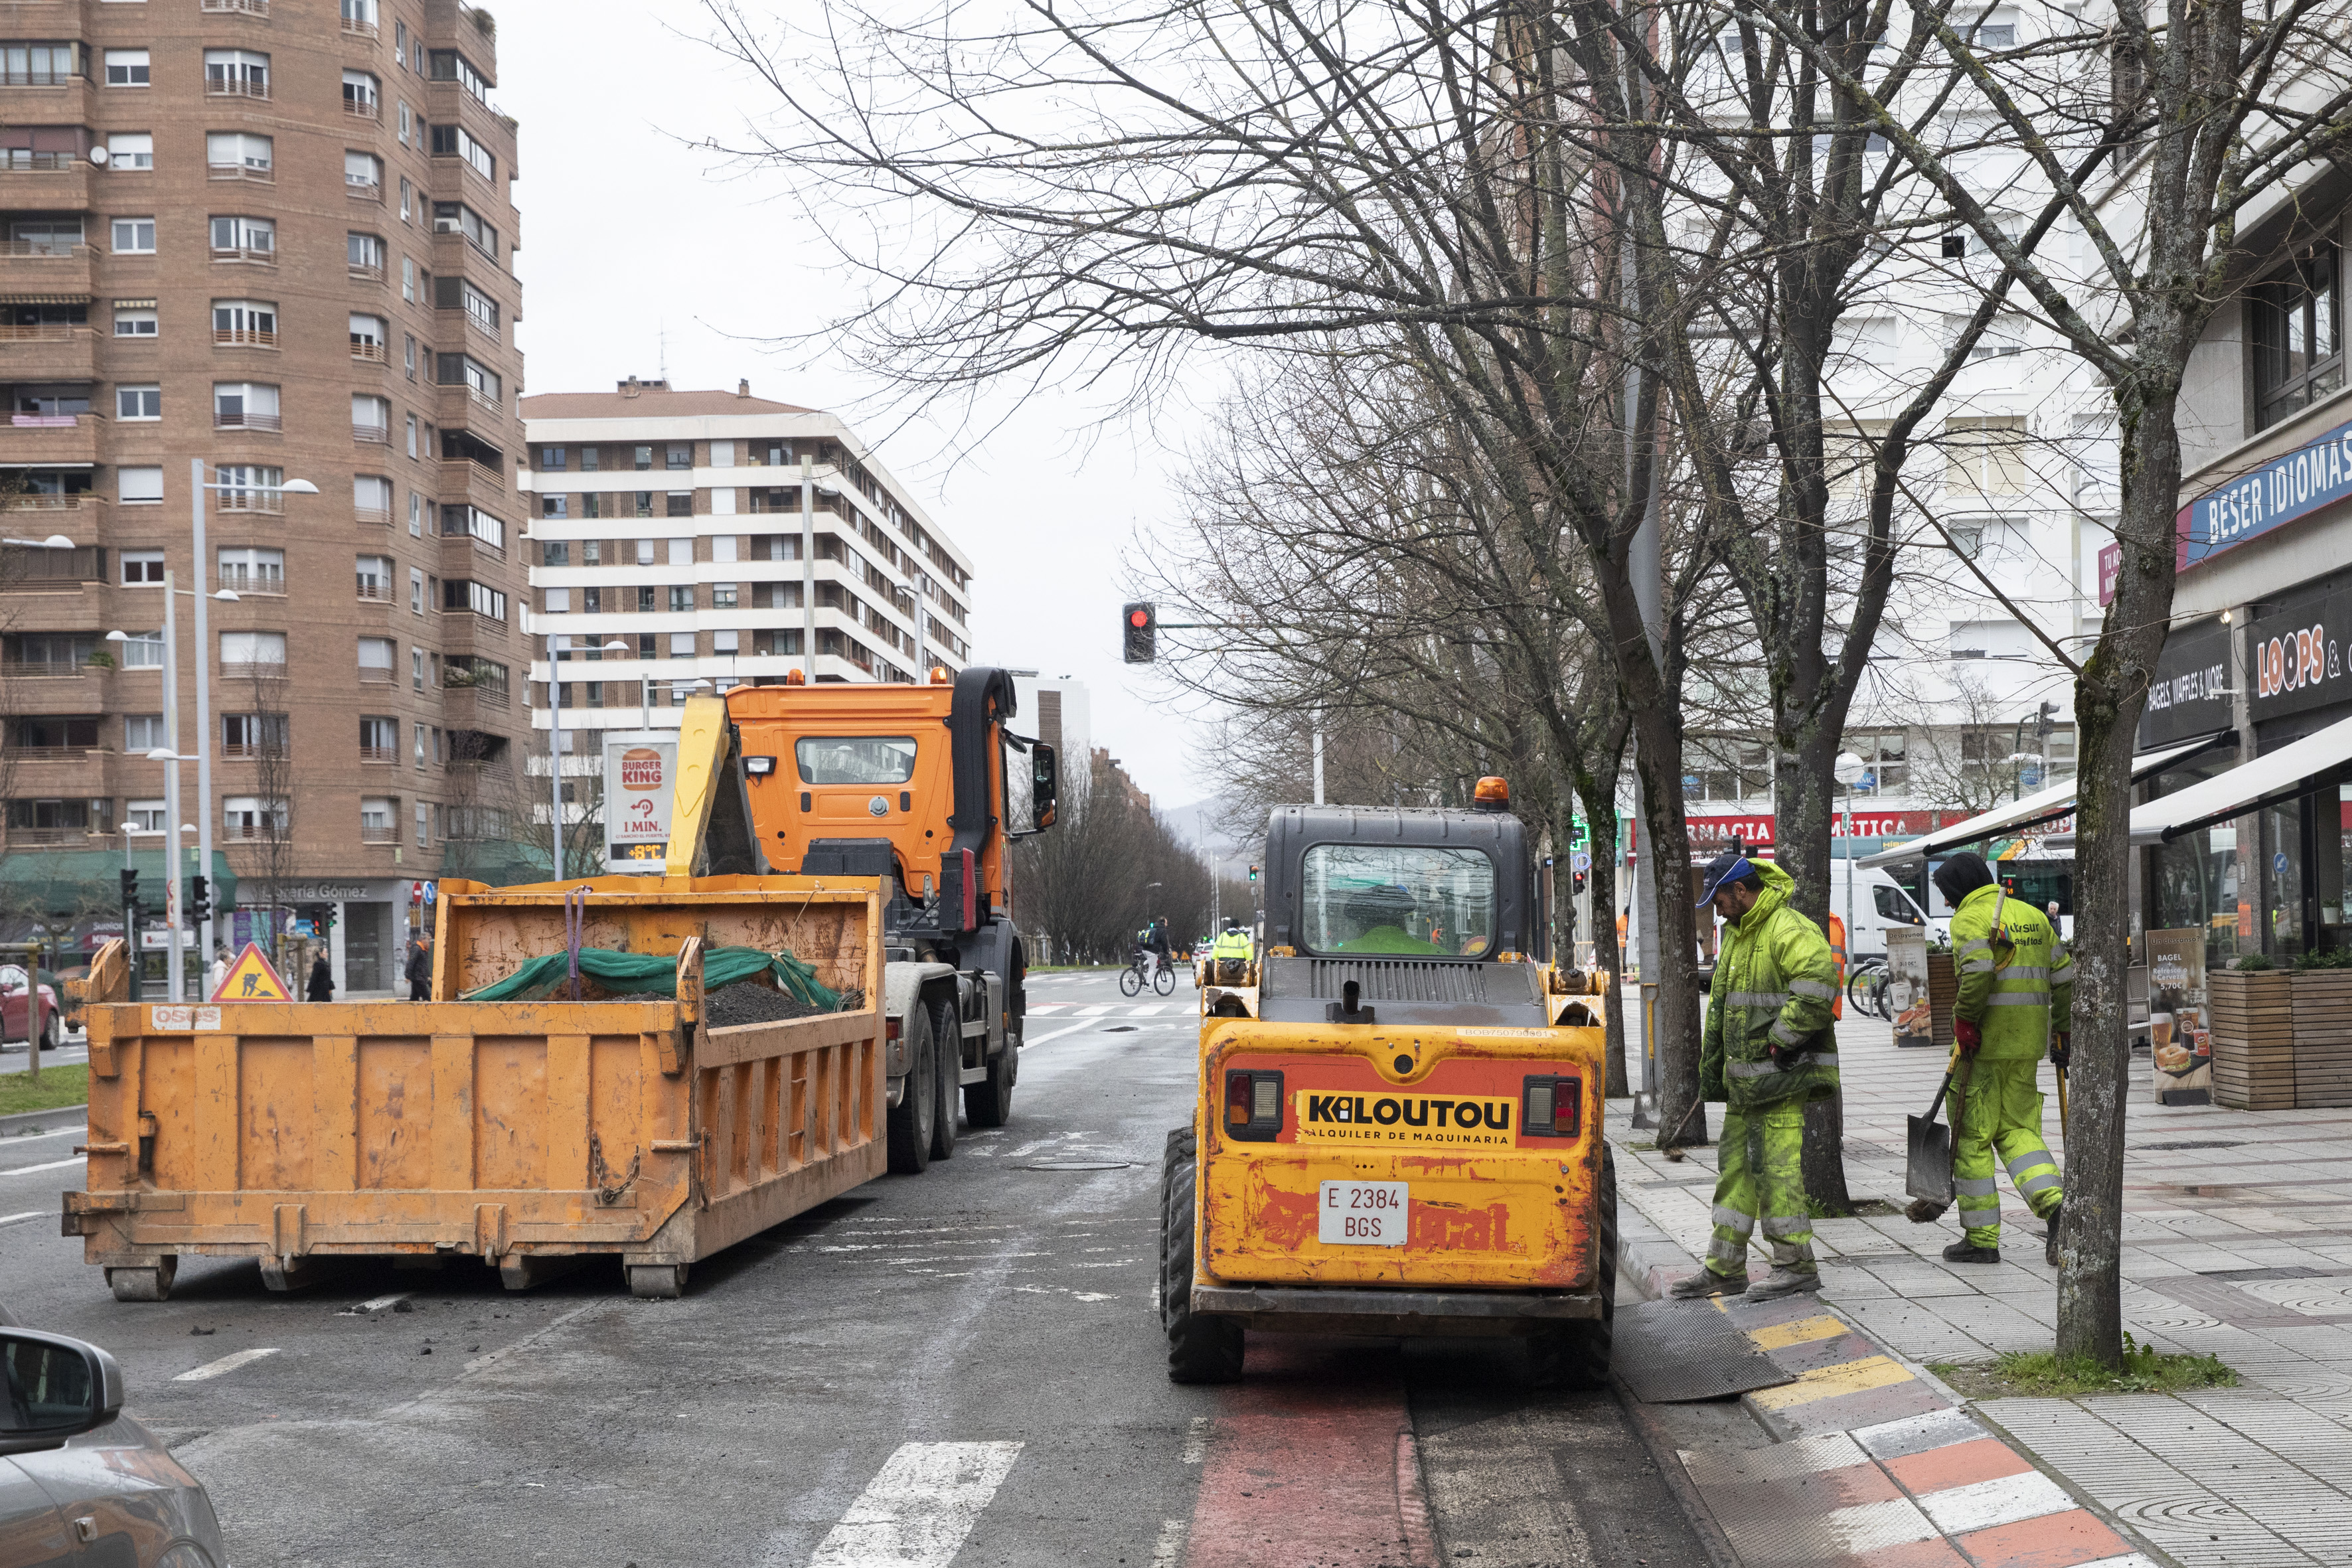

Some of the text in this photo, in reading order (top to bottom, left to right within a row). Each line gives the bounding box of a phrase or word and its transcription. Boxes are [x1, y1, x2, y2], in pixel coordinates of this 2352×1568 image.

[2209, 430, 2352, 544] BESER IDIOMAS
[2104, 553, 2112, 571] TU
[2258, 623, 2323, 698] LOOPS
[2327, 640, 2341, 678] &
[2172, 671, 2198, 705] WAFFLES
[2199, 670, 2205, 698] &
[2205, 663, 2223, 694] MORE
[622, 761, 662, 771] BURGER
[622, 770, 663, 783] KING
[624, 821, 663, 832] 1 MIN.
[1686, 815, 1909, 842] RMACIA MÉTICA
[319, 884, 368, 898] Gómez
[2163, 935, 2201, 944] descanso?
[2160, 982, 2182, 991] 5,70€
[1389, 1132, 1406, 1140] DE
[1413, 1133, 1508, 1144] MAQUINARIA
[1328, 1188, 1399, 1210] E 2384
[1345, 1217, 1382, 1238] BGS
